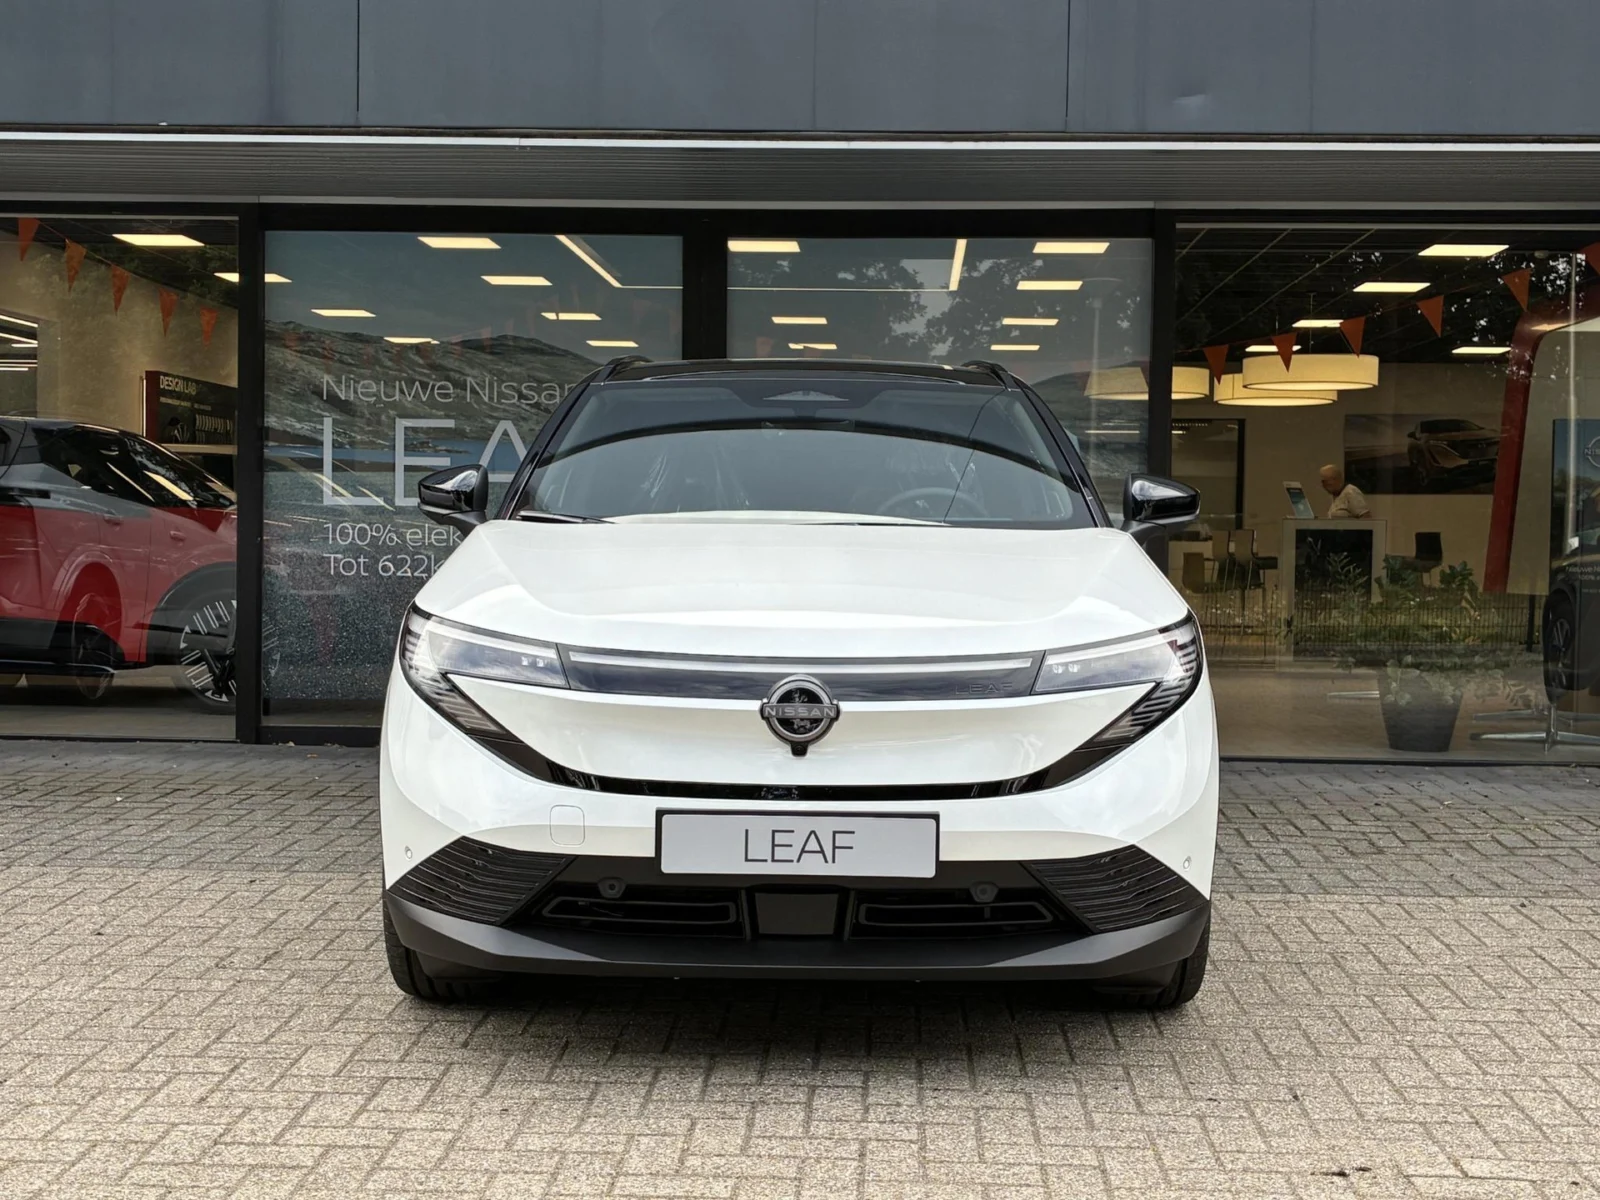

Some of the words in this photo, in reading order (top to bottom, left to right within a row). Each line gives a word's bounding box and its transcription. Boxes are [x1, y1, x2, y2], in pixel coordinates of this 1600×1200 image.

[160, 375, 183, 392] DESIGN
[184, 381, 197, 395] LAB
[322, 375, 454, 403] Nieuwe
[323, 523, 397, 547] 100%
[323, 554, 369, 577] Tot
[955, 681, 1012, 695] LEAF
[765, 707, 835, 717] NISSAN
[744, 829, 855, 864] LEAF
